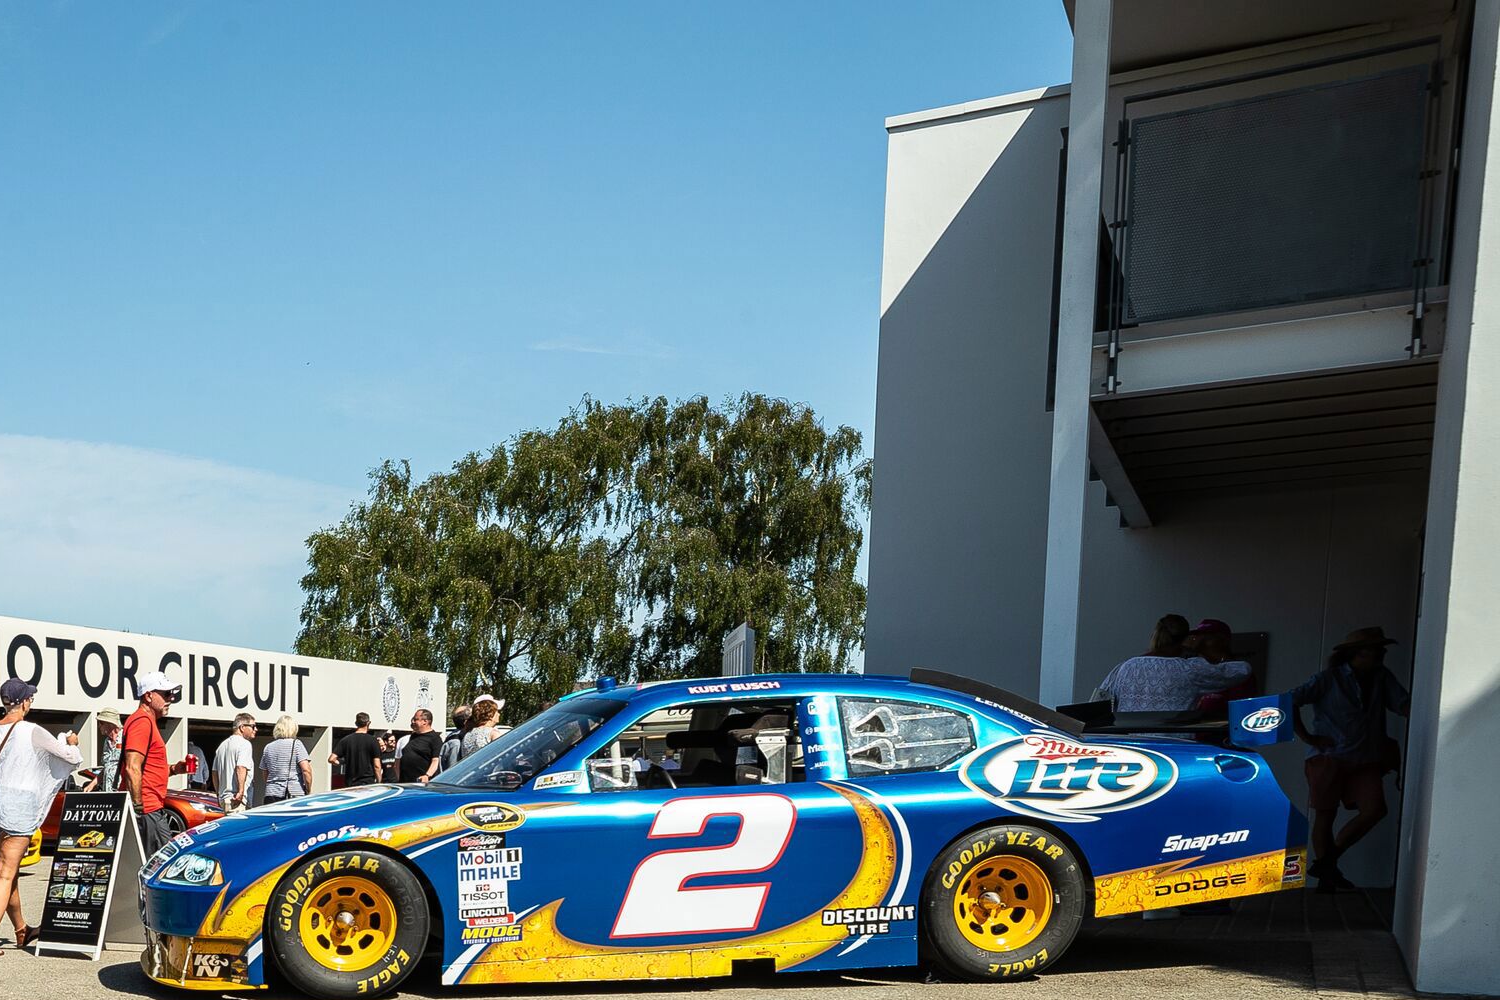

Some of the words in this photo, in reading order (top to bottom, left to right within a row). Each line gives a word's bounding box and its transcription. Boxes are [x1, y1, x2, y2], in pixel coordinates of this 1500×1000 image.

[688, 684, 727, 695] KURT
[730, 681, 781, 692] BUSCH
[1024, 736, 1113, 757] Miller
[1003, 758, 1144, 801] Lite
[63, 810, 120, 822] DAYTONA
[479, 812, 504, 823] Sprint
[297, 824, 394, 853] GOODYEAR
[1161, 829, 1250, 853] Snap-on
[461, 850, 503, 866] Mobil
[609, 792, 798, 939] 2
[1155, 873, 1246, 897] DODGE
[461, 891, 505, 901] TISSOT
[56, 911, 74, 919] BOOK
[74, 912, 90, 920] NOW
[462, 908, 506, 918] LINCOLN
[822, 905, 916, 925] DISCOUNT
[461, 925, 522, 939] MOOG
[847, 922, 889, 935] TIRE
[357, 949, 411, 994] EAGLE
[989, 948, 1049, 977] EAGLE
